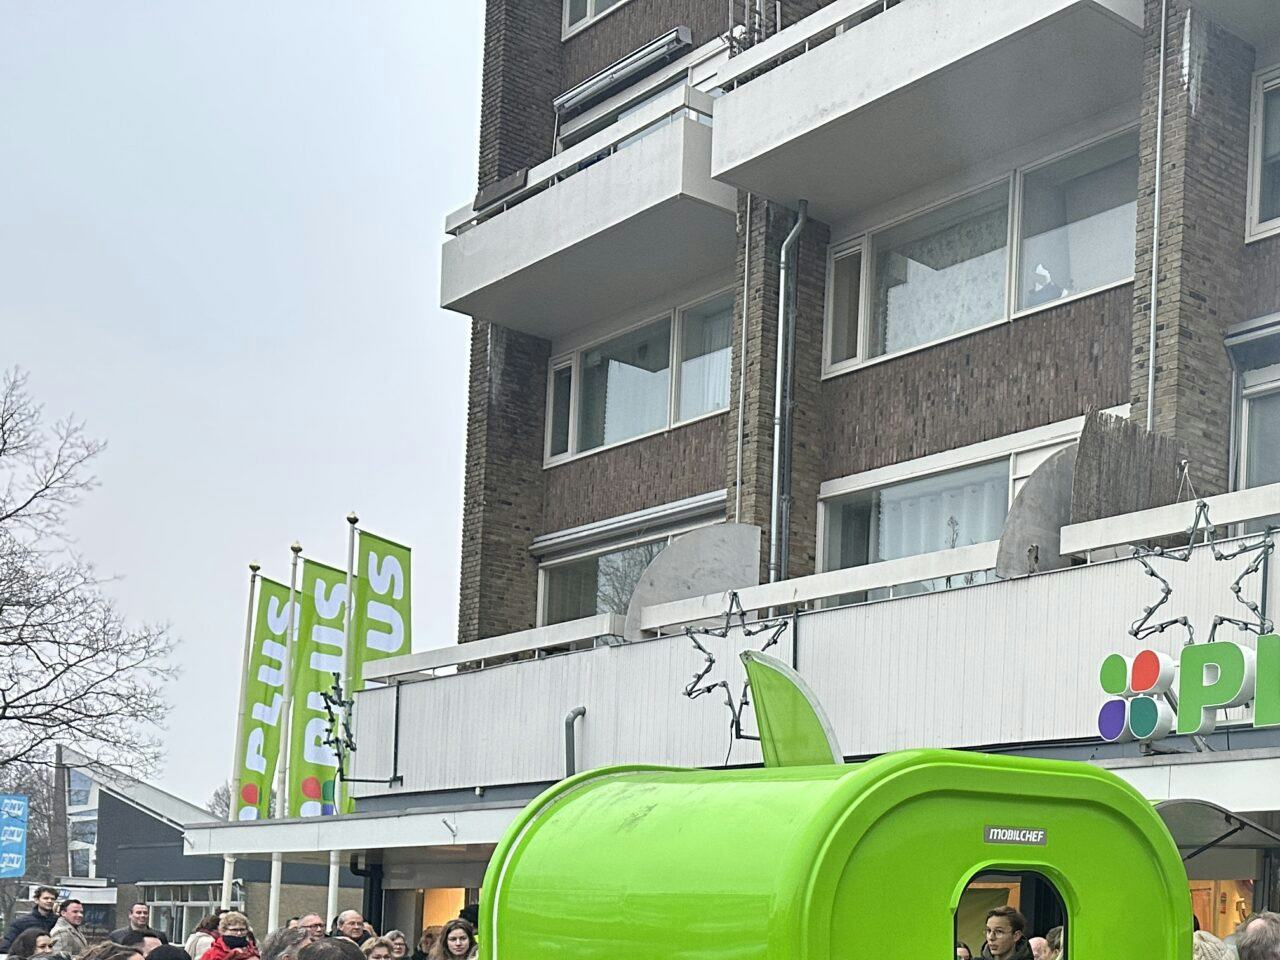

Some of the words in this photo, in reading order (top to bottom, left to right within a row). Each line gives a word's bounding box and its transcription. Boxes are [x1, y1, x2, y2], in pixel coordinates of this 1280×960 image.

[366, 551, 404, 653] US
[245, 595, 301, 774] PLUS
[989, 828, 1045, 842] MOBILCHEF
